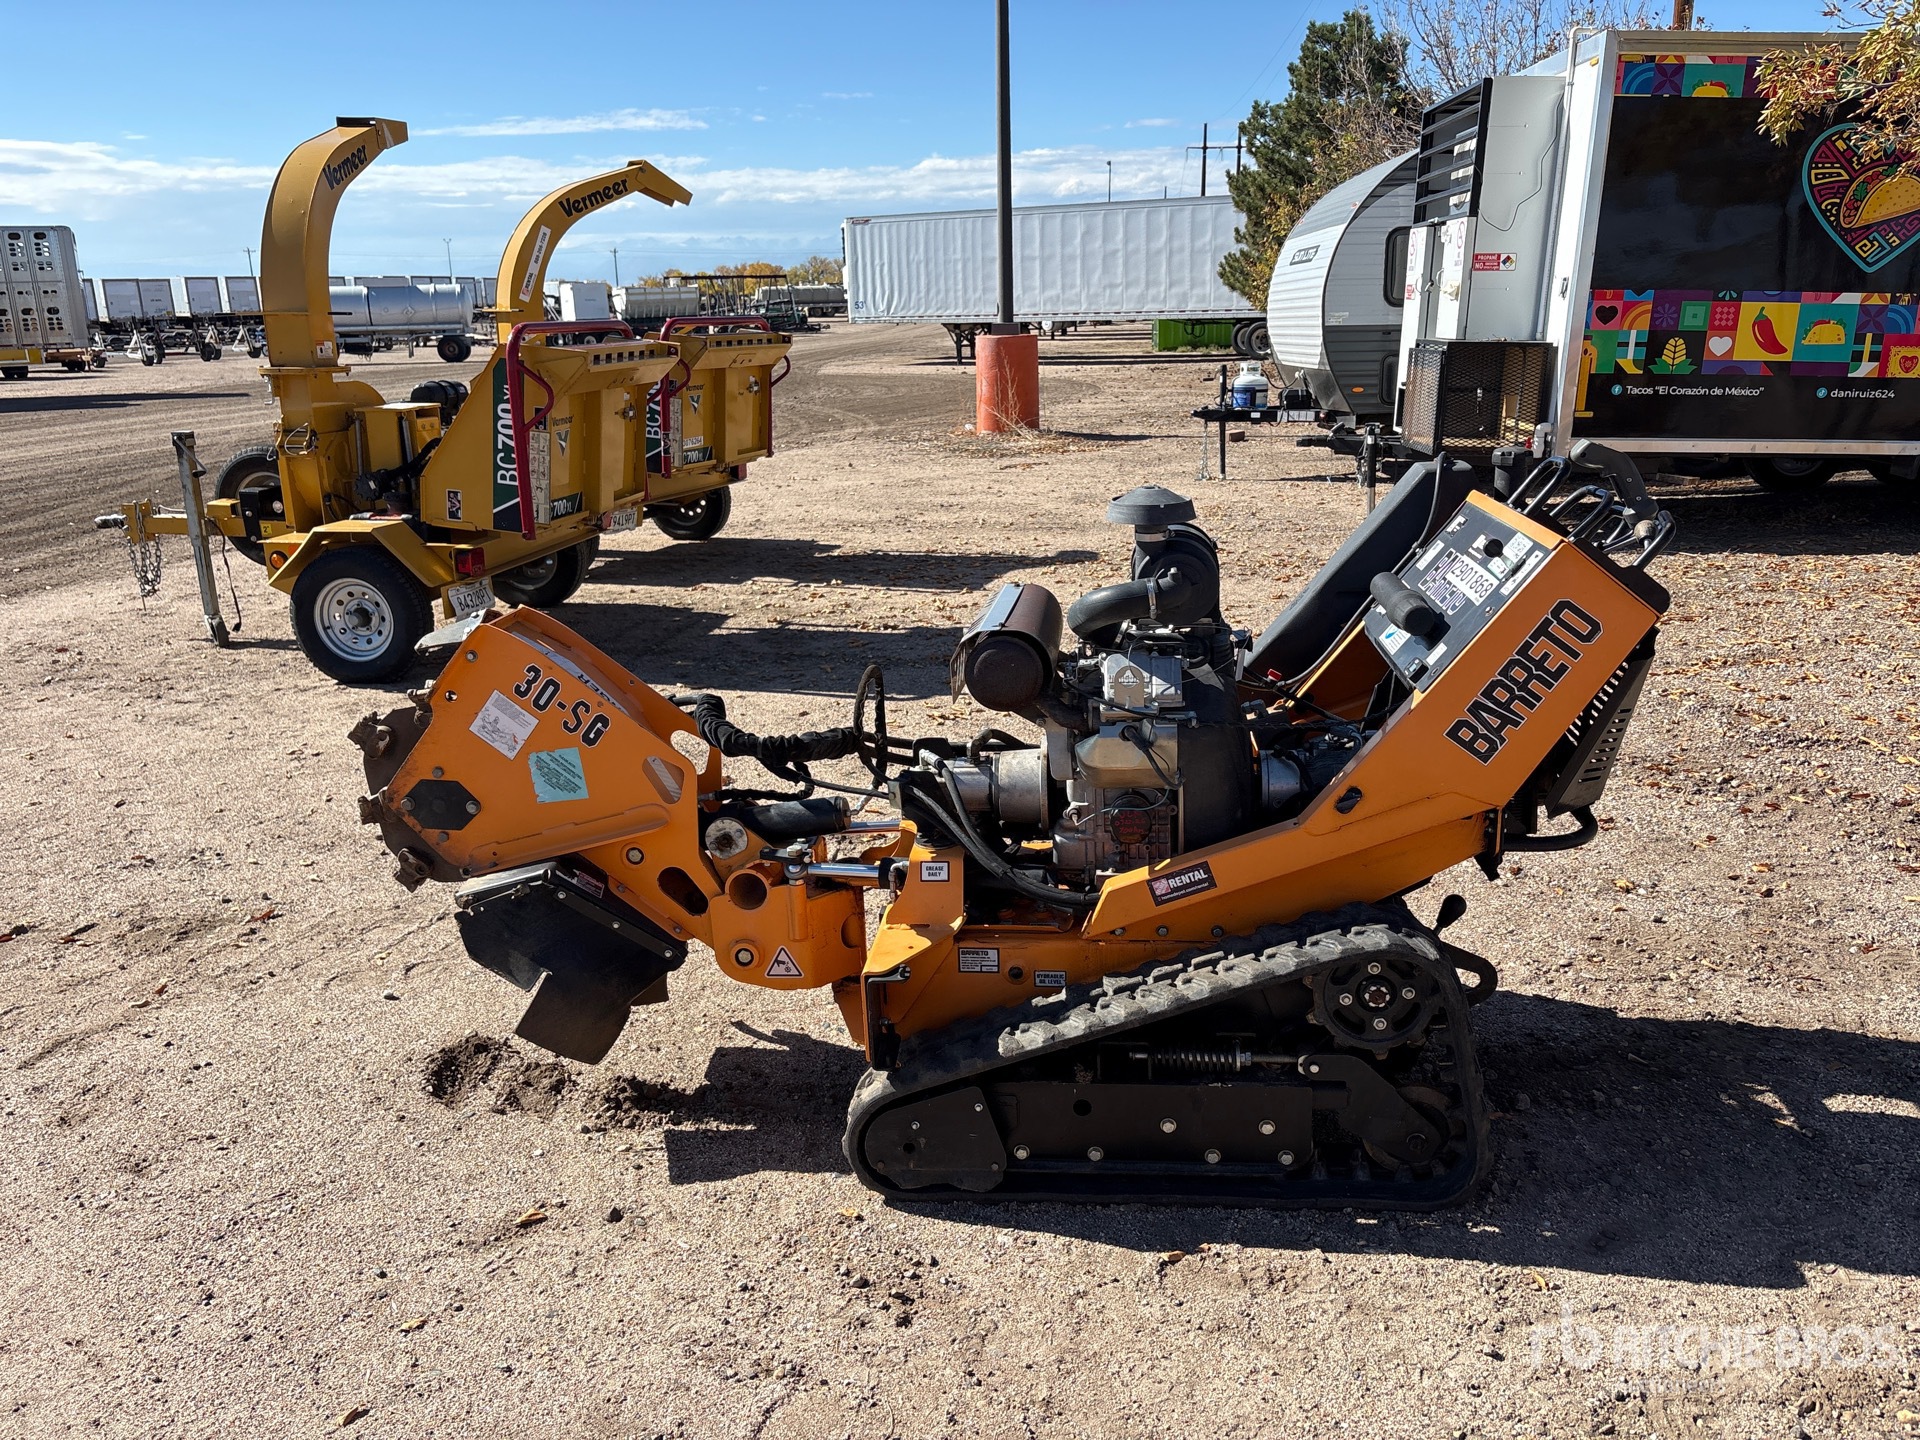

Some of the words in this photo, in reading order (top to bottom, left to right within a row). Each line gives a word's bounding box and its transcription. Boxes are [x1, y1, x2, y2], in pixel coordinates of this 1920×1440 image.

[322, 144, 368, 190] Vermeer
[558, 178, 628, 218] Vermeer
[1626, 385, 1654, 395] Tacos
[1669, 386, 1709, 395] Corazón
[1710, 386, 1724, 395] de
[1830, 388, 1896, 398] daniruiz624
[1450, 556, 1495, 599] 2901868
[1443, 598, 1603, 766] BARRETO
[512, 662, 611, 749] 30-SG
[1168, 869, 1208, 889] RENTAL
